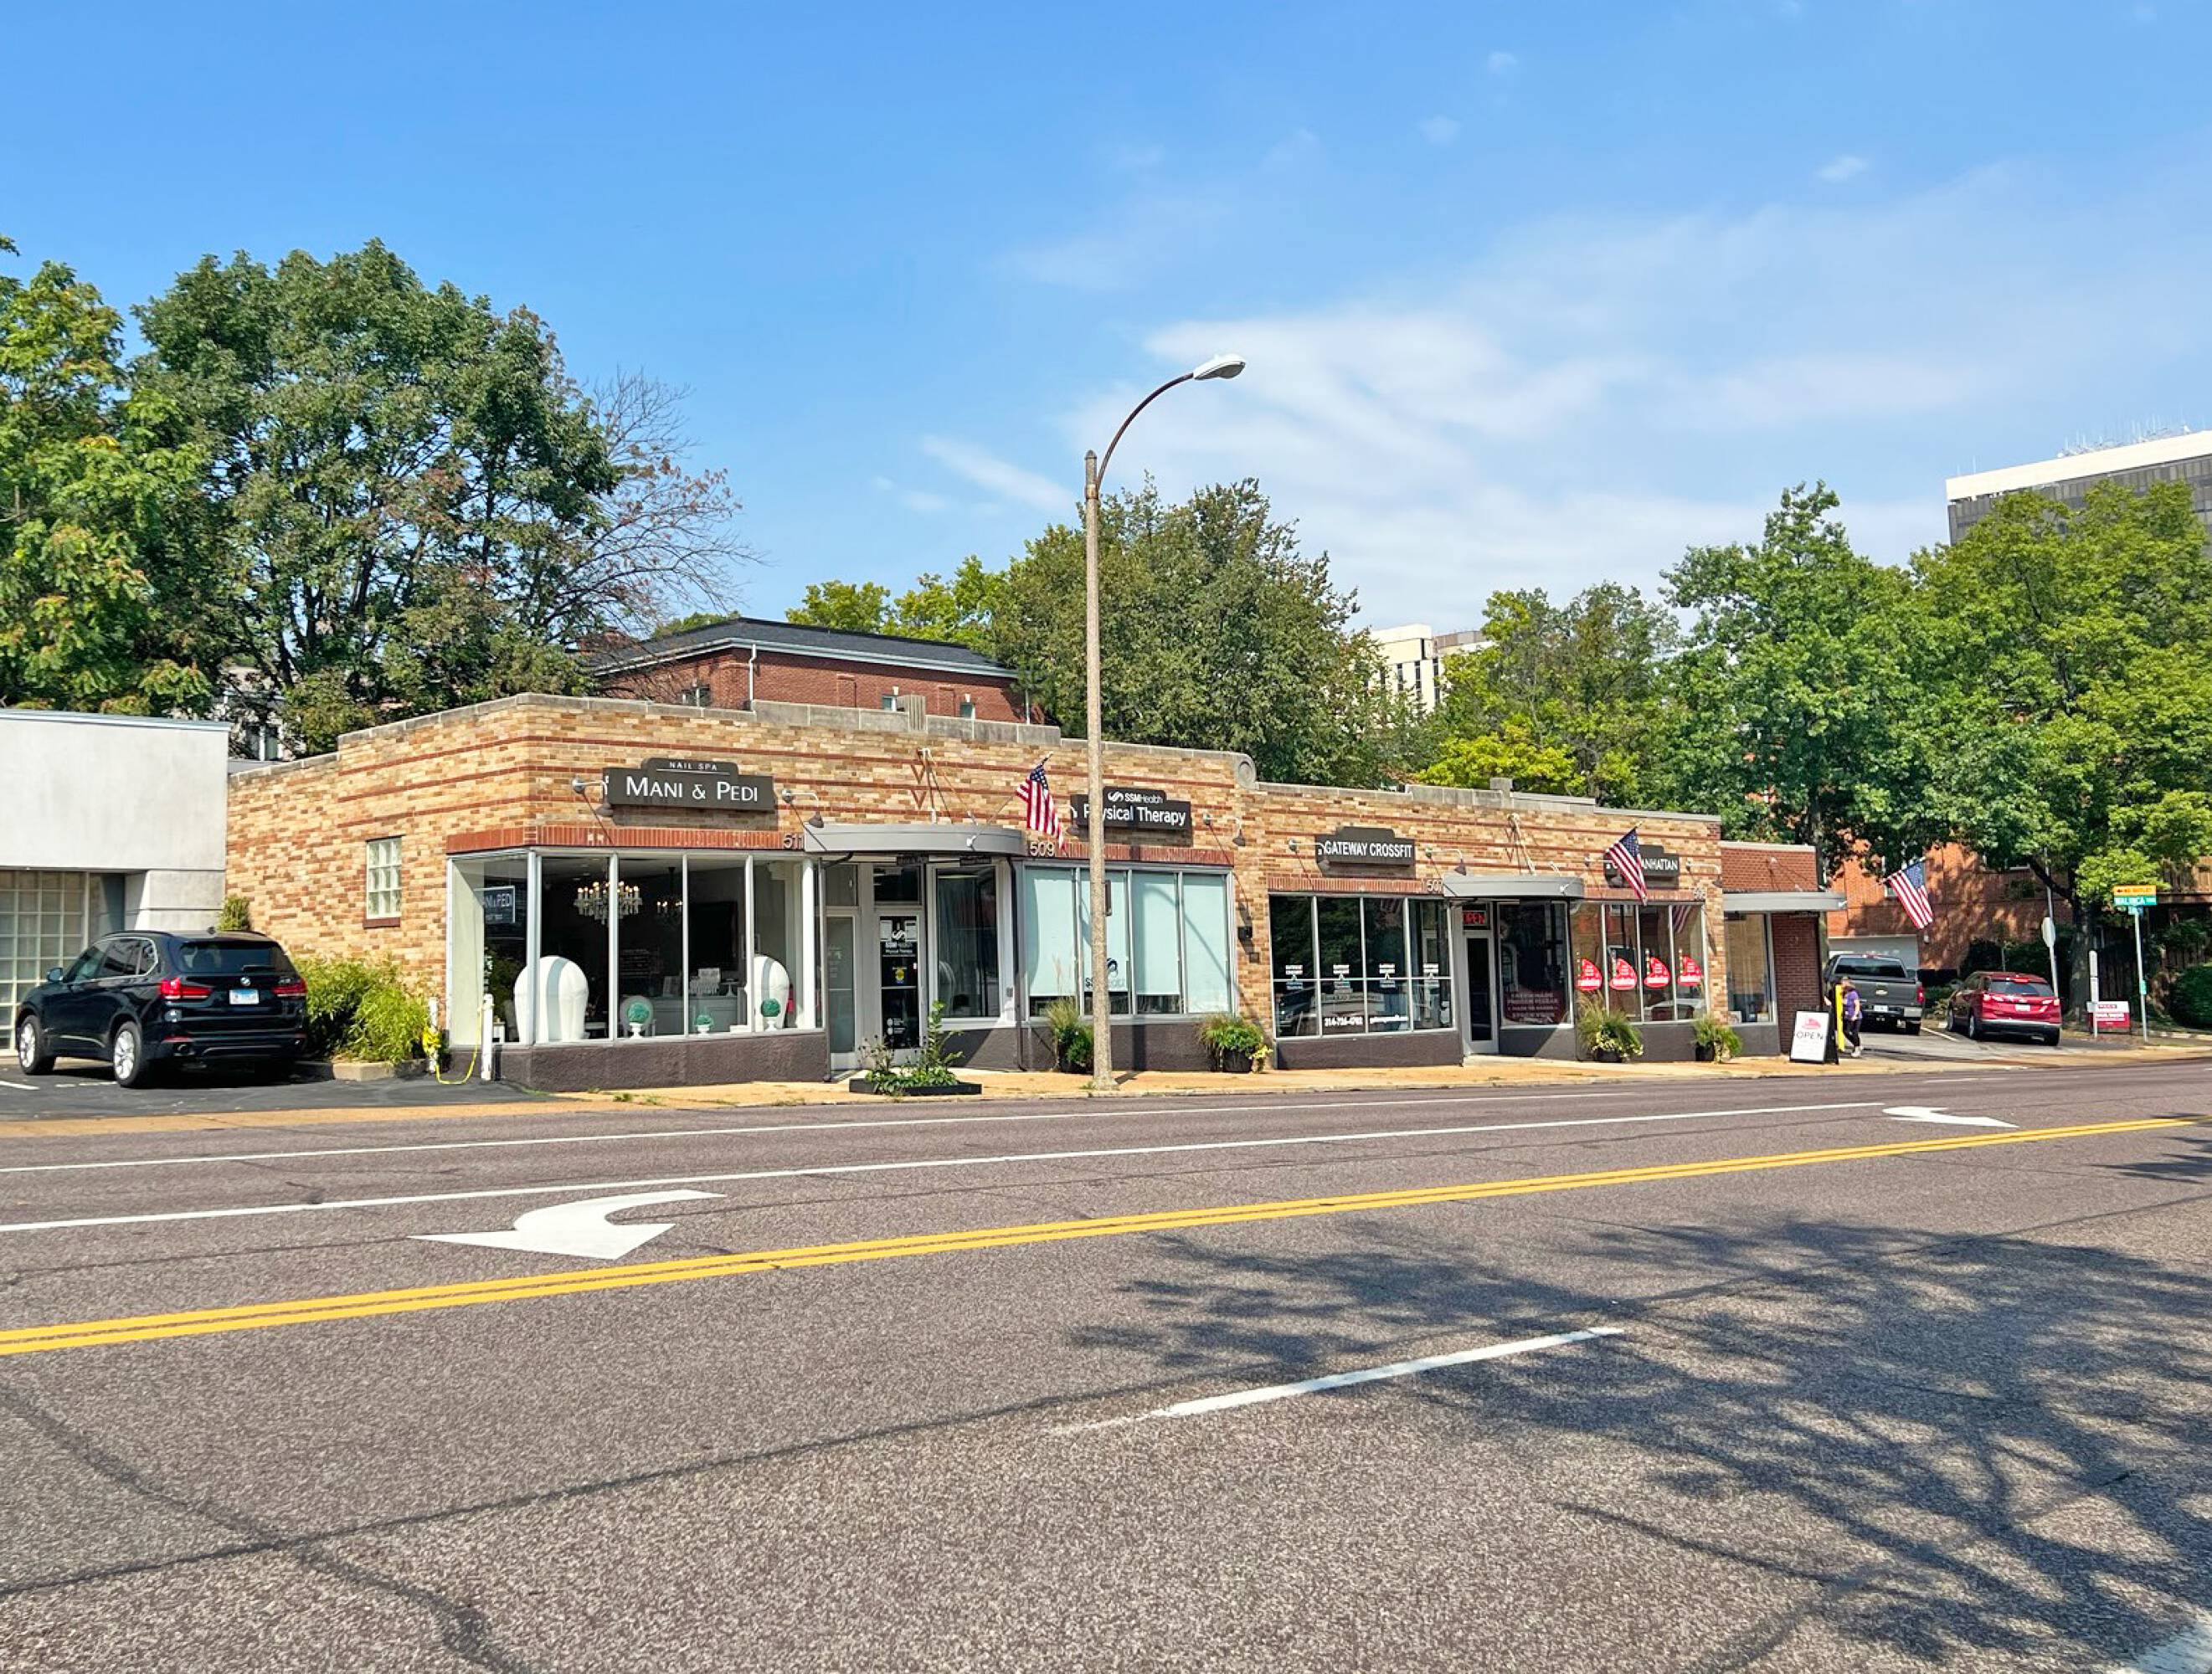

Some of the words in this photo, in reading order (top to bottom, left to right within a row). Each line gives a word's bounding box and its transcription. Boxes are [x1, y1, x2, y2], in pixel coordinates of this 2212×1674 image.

[697, 763, 718, 772] SPA
[692, 783, 706, 800] &
[1137, 806, 1186, 827] Therapy
[1030, 840, 1055, 857] 509
[1325, 840, 1368, 856] GATEWAY
[1370, 842, 1412, 859] CROSSFIT
[1796, 1030, 1824, 1040] OPEN
